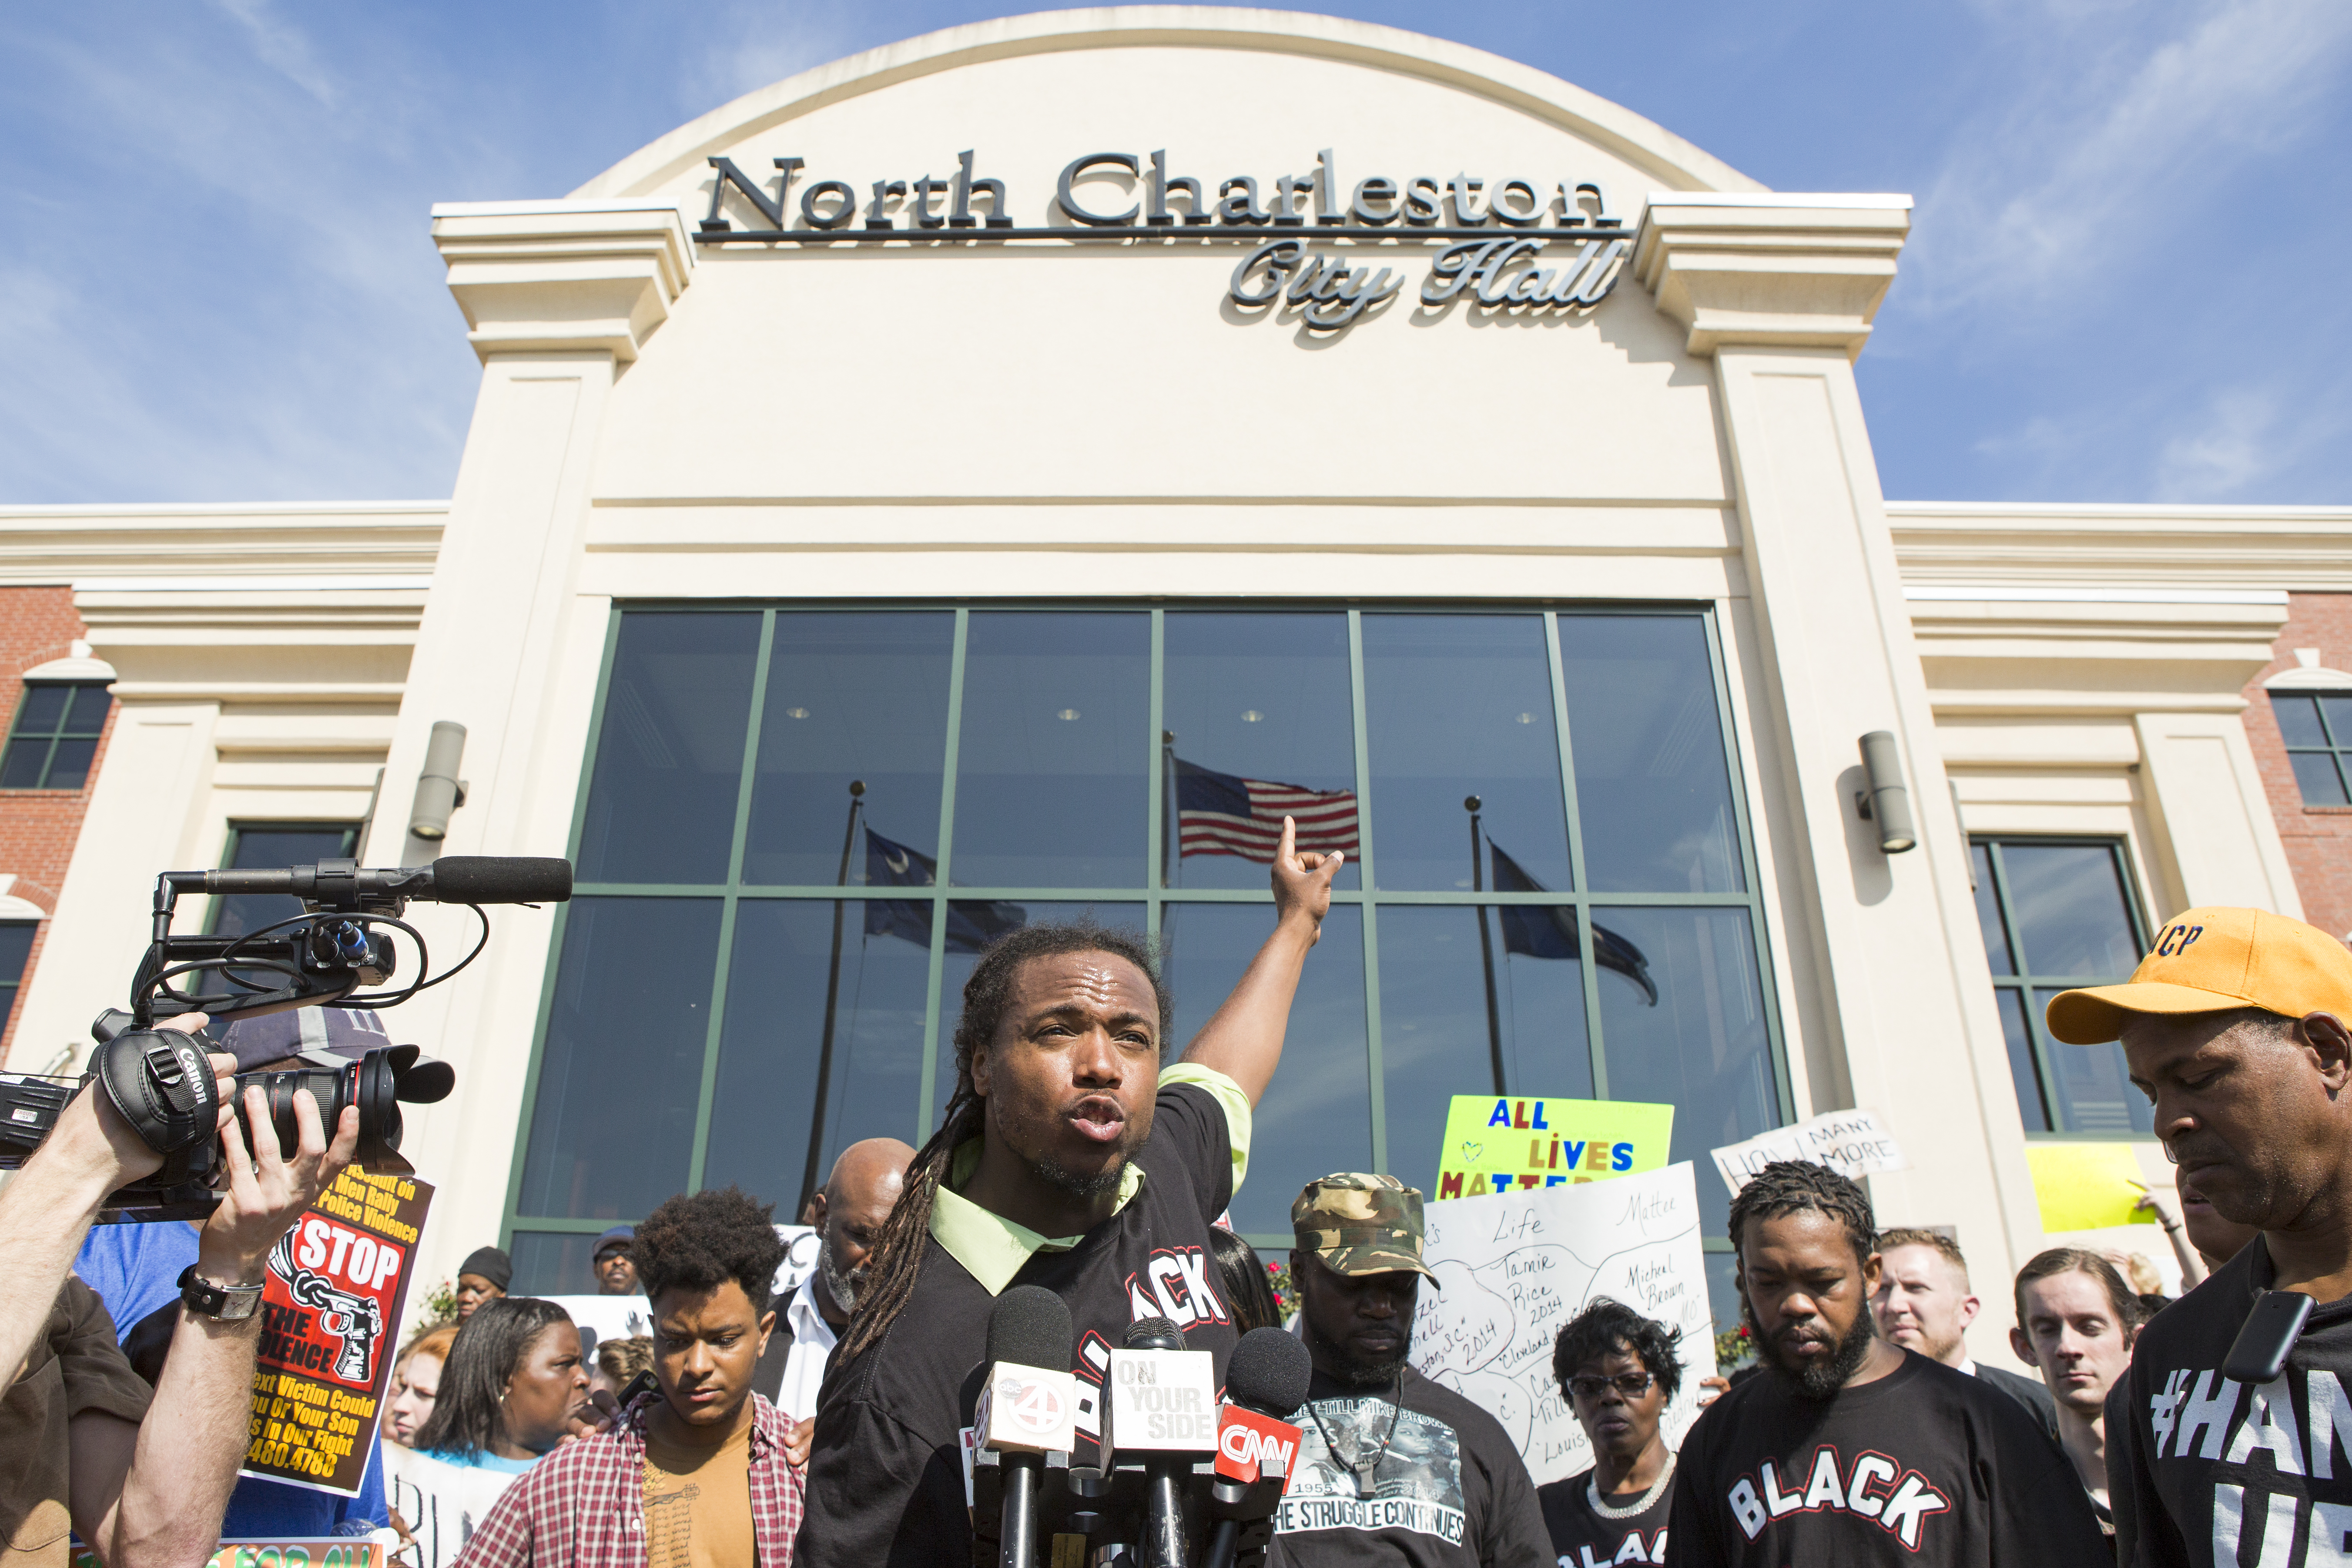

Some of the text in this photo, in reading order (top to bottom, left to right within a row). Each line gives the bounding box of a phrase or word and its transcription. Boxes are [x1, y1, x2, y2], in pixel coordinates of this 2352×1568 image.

[698, 148, 1622, 231] North Charleston
[1230, 236, 1624, 332] City Hall
[180, 1048, 208, 1104] Canon
[1488, 1099, 1548, 1130] ALL
[1809, 1118, 1872, 1145] MANY
[1820, 1140, 1895, 1165] MORE
[335, 1173, 400, 1216] Men Rally
[397, 1180, 416, 1201] on
[1440, 1171, 1593, 1199] MATT
[317, 1189, 418, 1244] Police Violence
[1493, 1209, 1545, 1243] Life
[299, 1219, 400, 1291] STOP
[1508, 1283, 1552, 1310] Rice
[1531, 1296, 1562, 1327] 2014
[263, 1302, 312, 1338] THE
[1463, 1318, 1497, 1366] 2014
[999, 1382, 1022, 1394] abc
[1117, 1360, 1157, 1386] ON
[278, 1375, 329, 1407] Victim
[329, 1389, 376, 1418] Could
[1127, 1386, 1203, 1413] YOUR
[1322, 1399, 1358, 1415] TILL
[1358, 1399, 1397, 1418] MIKE
[270, 1397, 291, 1419] Or
[292, 1401, 329, 1428] Your
[328, 1411, 360, 1436] Son
[1148, 1413, 1213, 1440] SIDE
[262, 1418, 282, 1441] In
[282, 1423, 313, 1447] Our
[312, 1429, 354, 1457] Fight
[1220, 1424, 1294, 1465] CNN
[1295, 1483, 1333, 1494] 1955
[1402, 1484, 1440, 1501] 2014
[1727, 1448, 1947, 1549] BLACK
[1300, 1501, 1382, 1528] STRUGGLE
[1384, 1501, 1464, 1543] CONTINUES
